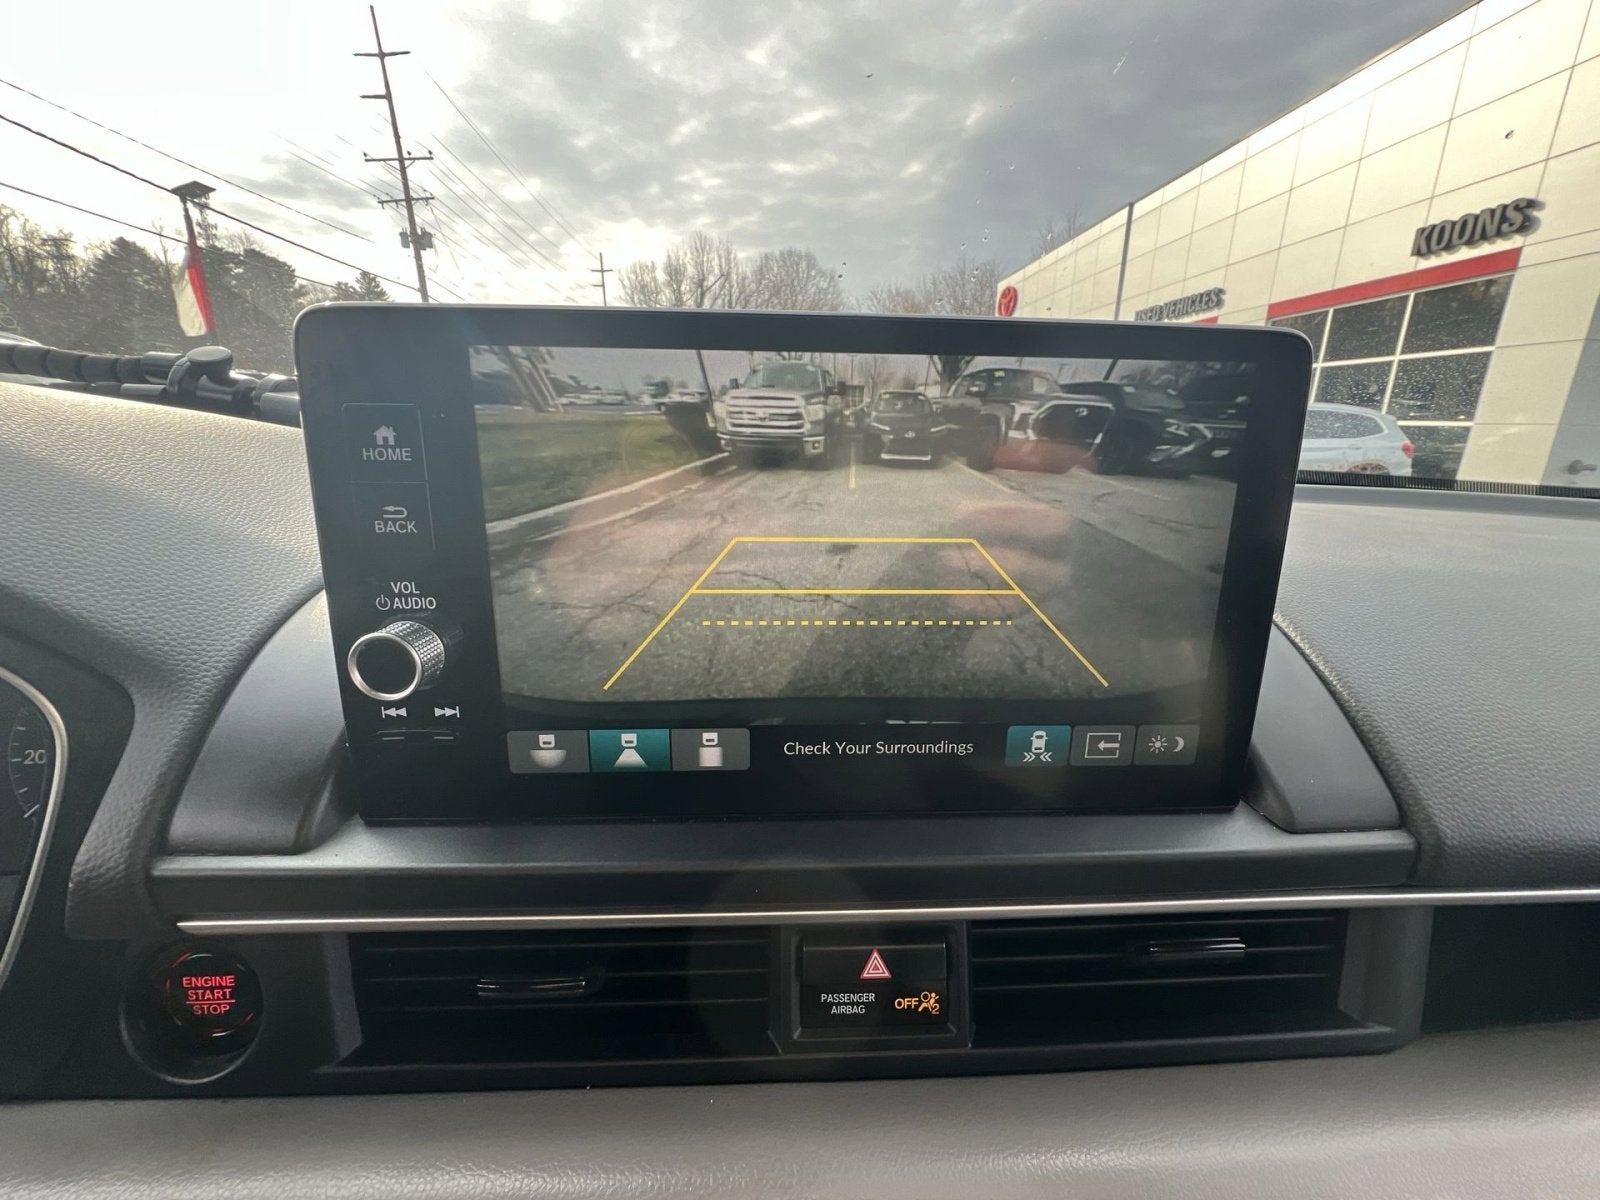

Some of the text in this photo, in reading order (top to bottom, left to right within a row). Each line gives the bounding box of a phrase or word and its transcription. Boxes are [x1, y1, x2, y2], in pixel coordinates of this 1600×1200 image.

[1410, 197, 1541, 259] KOONS
[1163, 287, 1226, 321] VEHICLES
[362, 447, 412, 461] HOME
[374, 520, 417, 533] BACK
[390, 581, 420, 594] VOL
[393, 596, 436, 610] AUDIO
[783, 740, 974, 756] Check Your Surroundings
[23, 749, 46, 764] 20
[182, 975, 235, 988] ENGINE
[187, 988, 232, 1000] START
[820, 993, 876, 1003] PASSENGER
[193, 1004, 230, 1015] STOP
[831, 1005, 866, 1015] AIRBAG
[894, 997, 919, 1010] OFF
